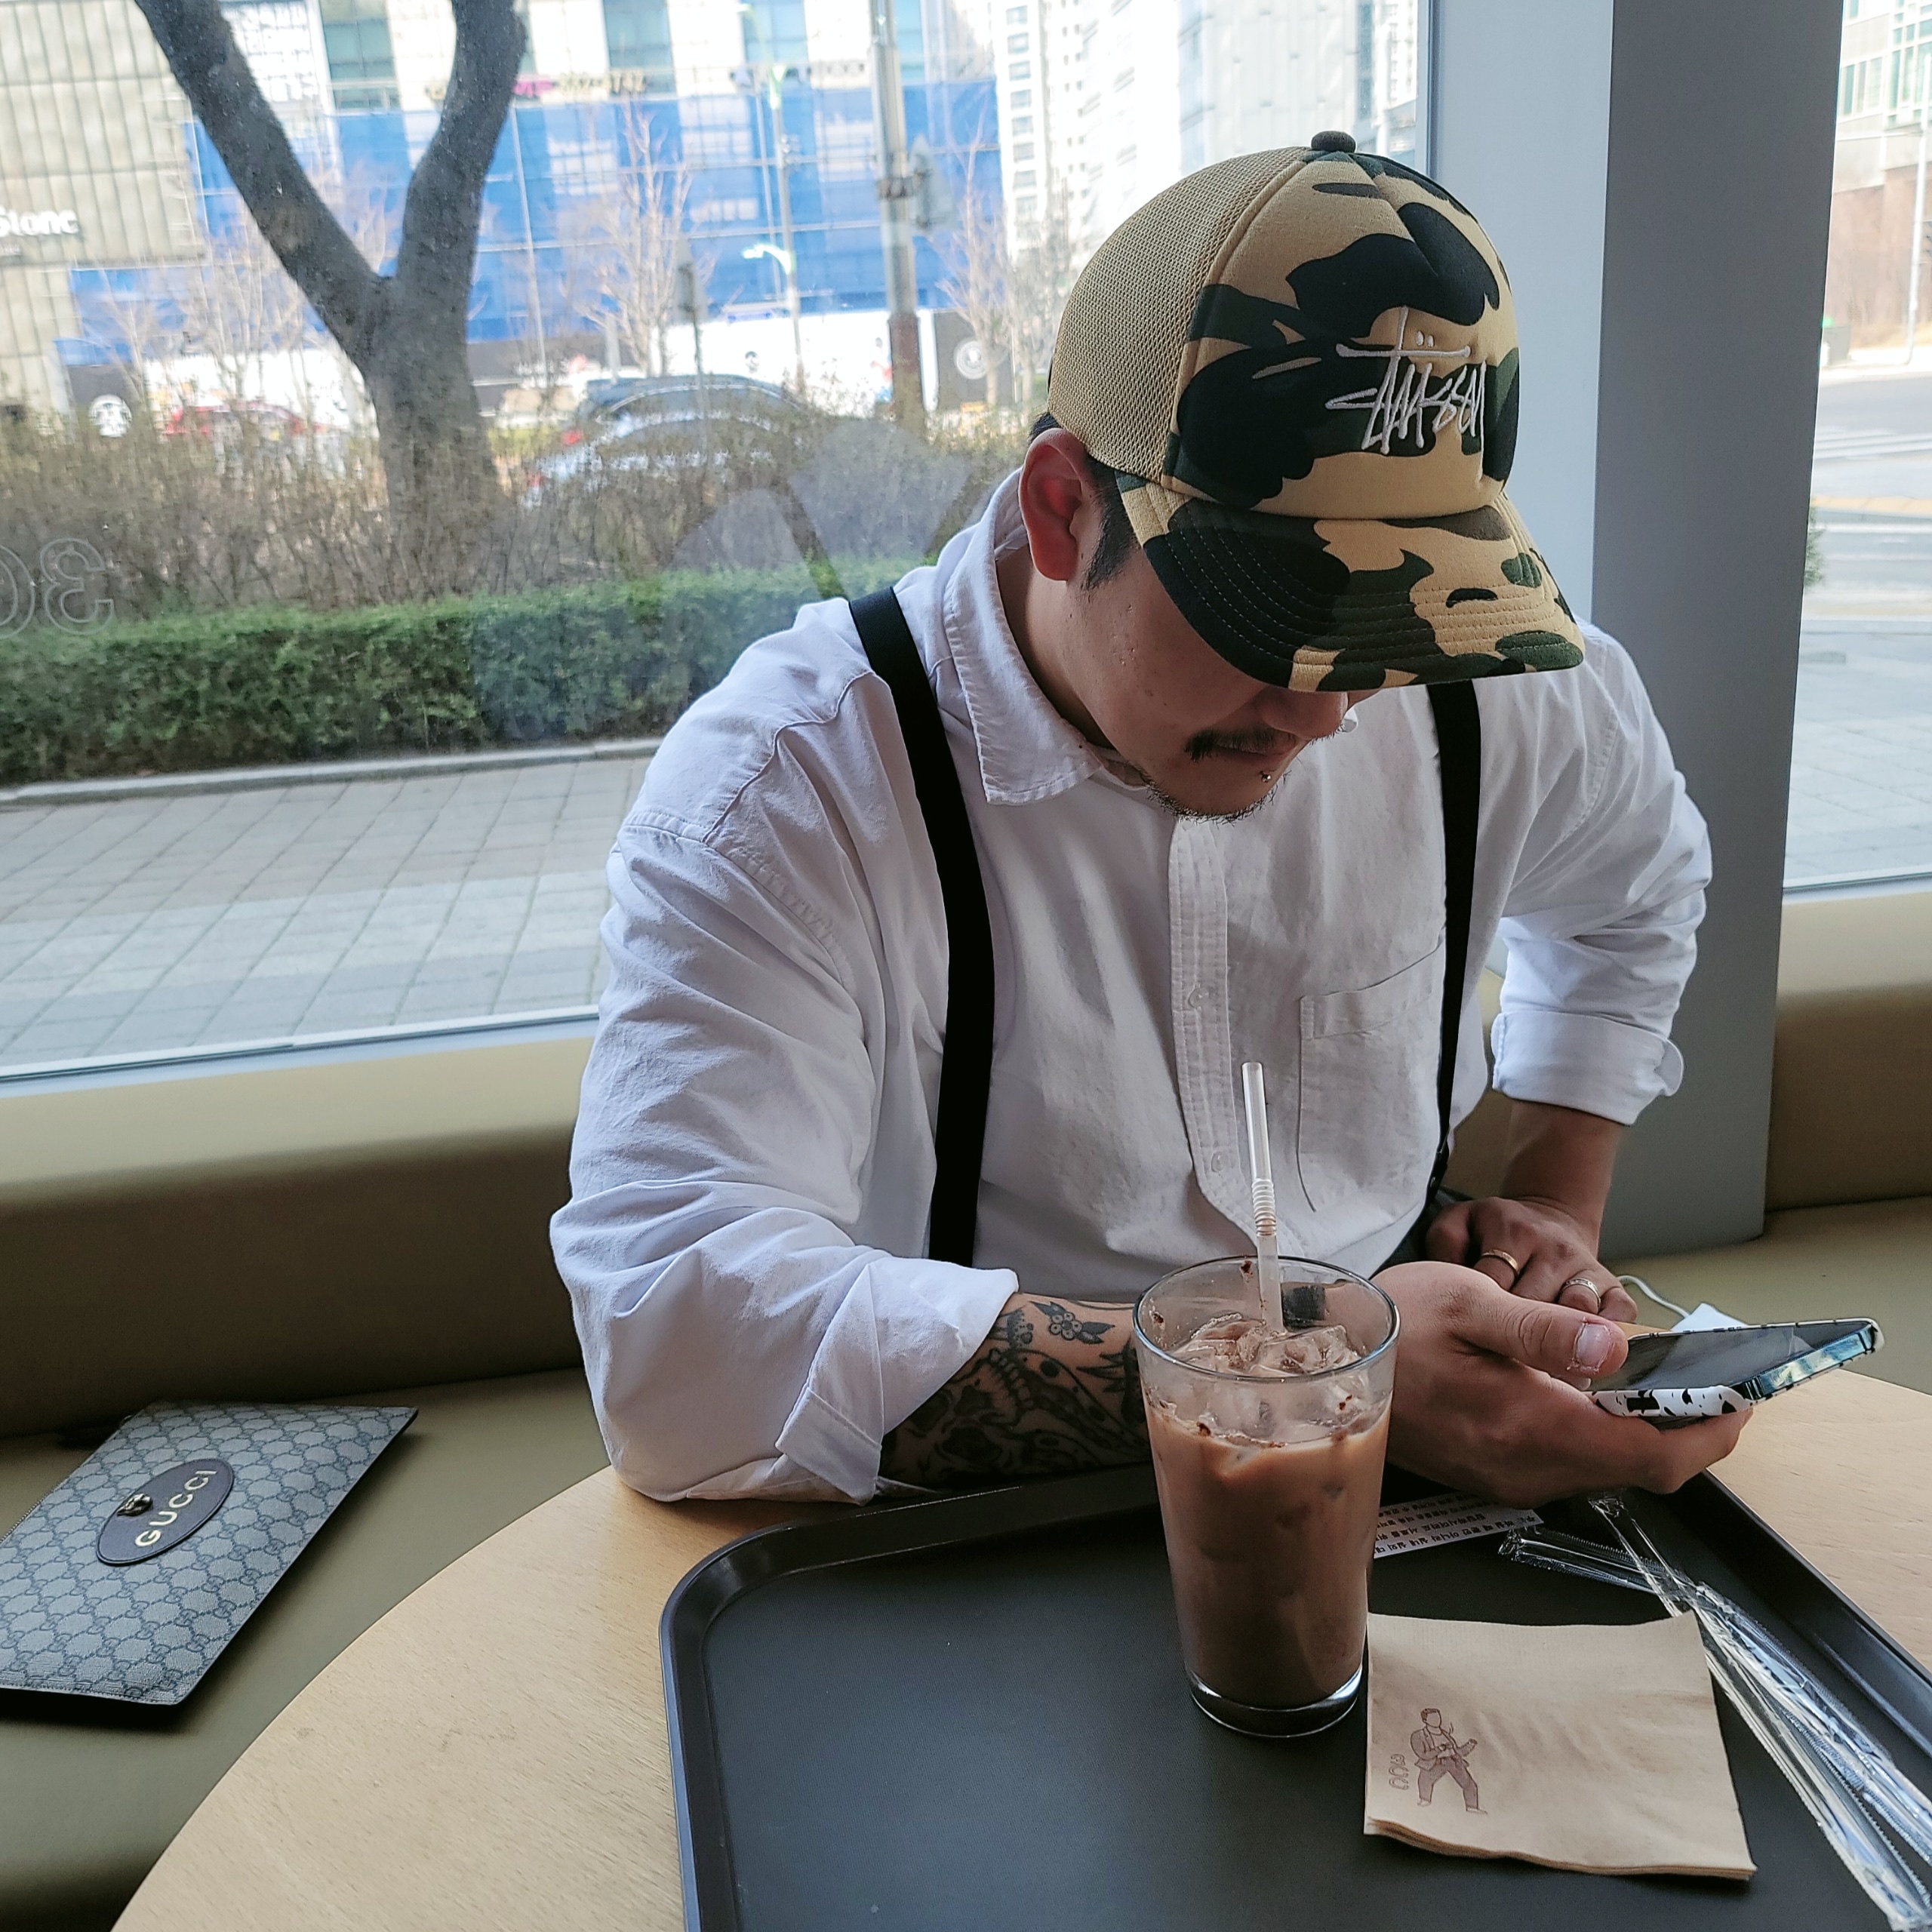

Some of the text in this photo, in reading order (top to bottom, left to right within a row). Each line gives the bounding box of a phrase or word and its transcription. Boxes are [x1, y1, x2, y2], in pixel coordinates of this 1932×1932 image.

[134, 1471, 217, 1547] GUCCI
[1430, 1531, 1459, 1541] 아니라
[1408, 1537, 1427, 1546] 실내
